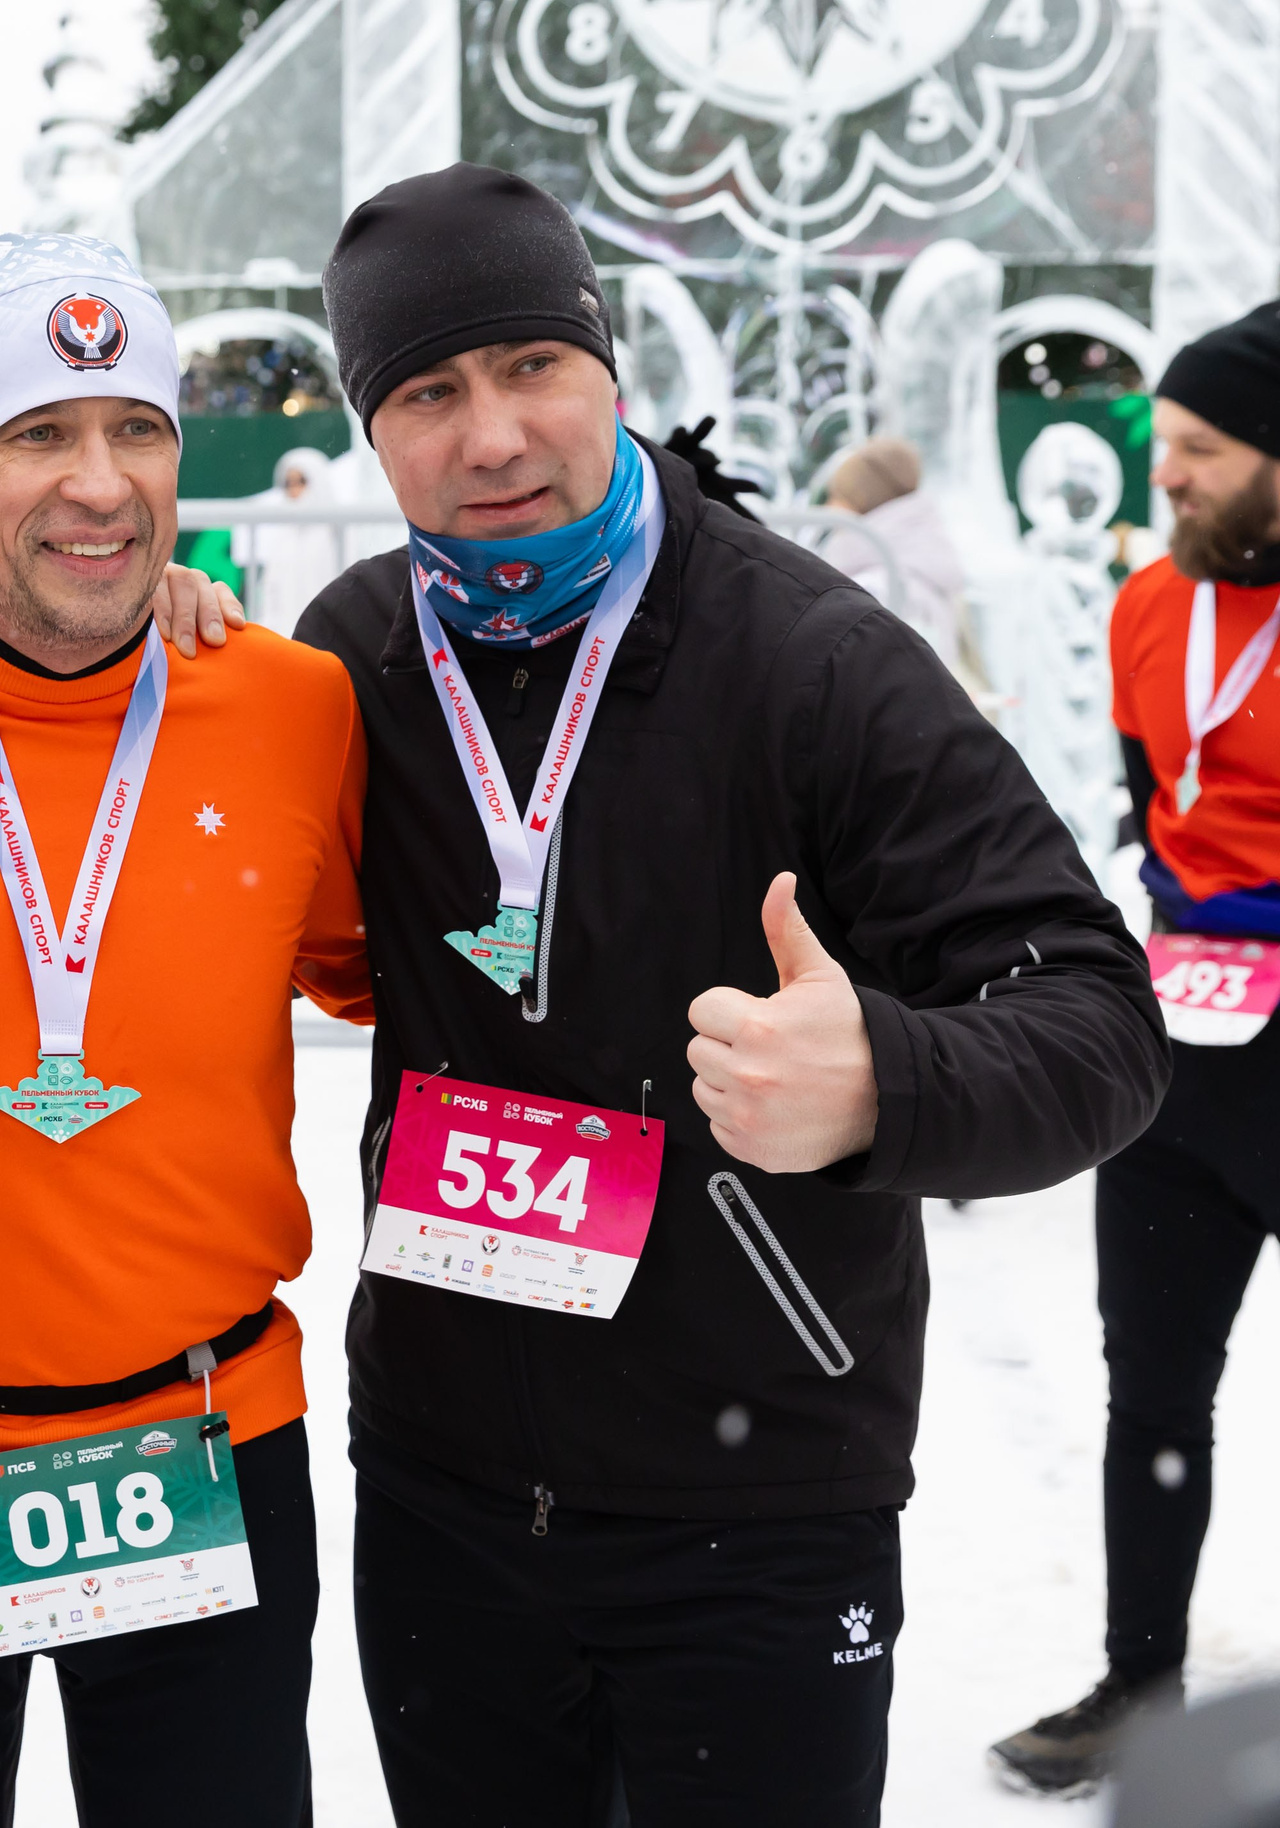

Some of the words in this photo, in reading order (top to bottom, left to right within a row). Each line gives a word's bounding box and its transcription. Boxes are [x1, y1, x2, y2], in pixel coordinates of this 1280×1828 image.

[565, 2, 611, 65] 8
[655, 89, 702, 151] 7
[541, 692, 587, 804] КАЛАШНИКОВ
[580, 636, 606, 688] СПОРТ
[443, 674, 488, 776] КАЛАШНИКОВ
[481, 775, 507, 823] СПОРТ
[74, 834, 114, 946] КАЛАШНИКОВ
[107, 778, 131, 829] СПОРТ
[29, 913, 53, 966] СПОРТ
[479, 937, 525, 950] ПЕЛЬМЕННЫЙ
[1152, 960, 1255, 1010] 493
[21, 1088, 73, 1097] ПЕЛЬМЕННЫЙ
[453, 1095, 488, 1112] РСХБ
[523, 1113, 553, 1126] КУБОК
[437, 1129, 591, 1233] 534
[430, 1227, 470, 1240] КАЛАШНИКОВ
[430, 1232, 448, 1240] СПОРТ
[77, 1441, 124, 1456] ПЕЛЬМЕННЫЙ
[138, 1440, 176, 1454] ВОСТОЧНЫЙ
[78, 1450, 114, 1464] КУБОК
[7, 1461, 37, 1475] ПСБ
[8, 1471, 174, 1568] 018
[23, 1587, 66, 1600] КАЛАШНИКОВ
[24, 1597, 44, 1605] СПОРТ
